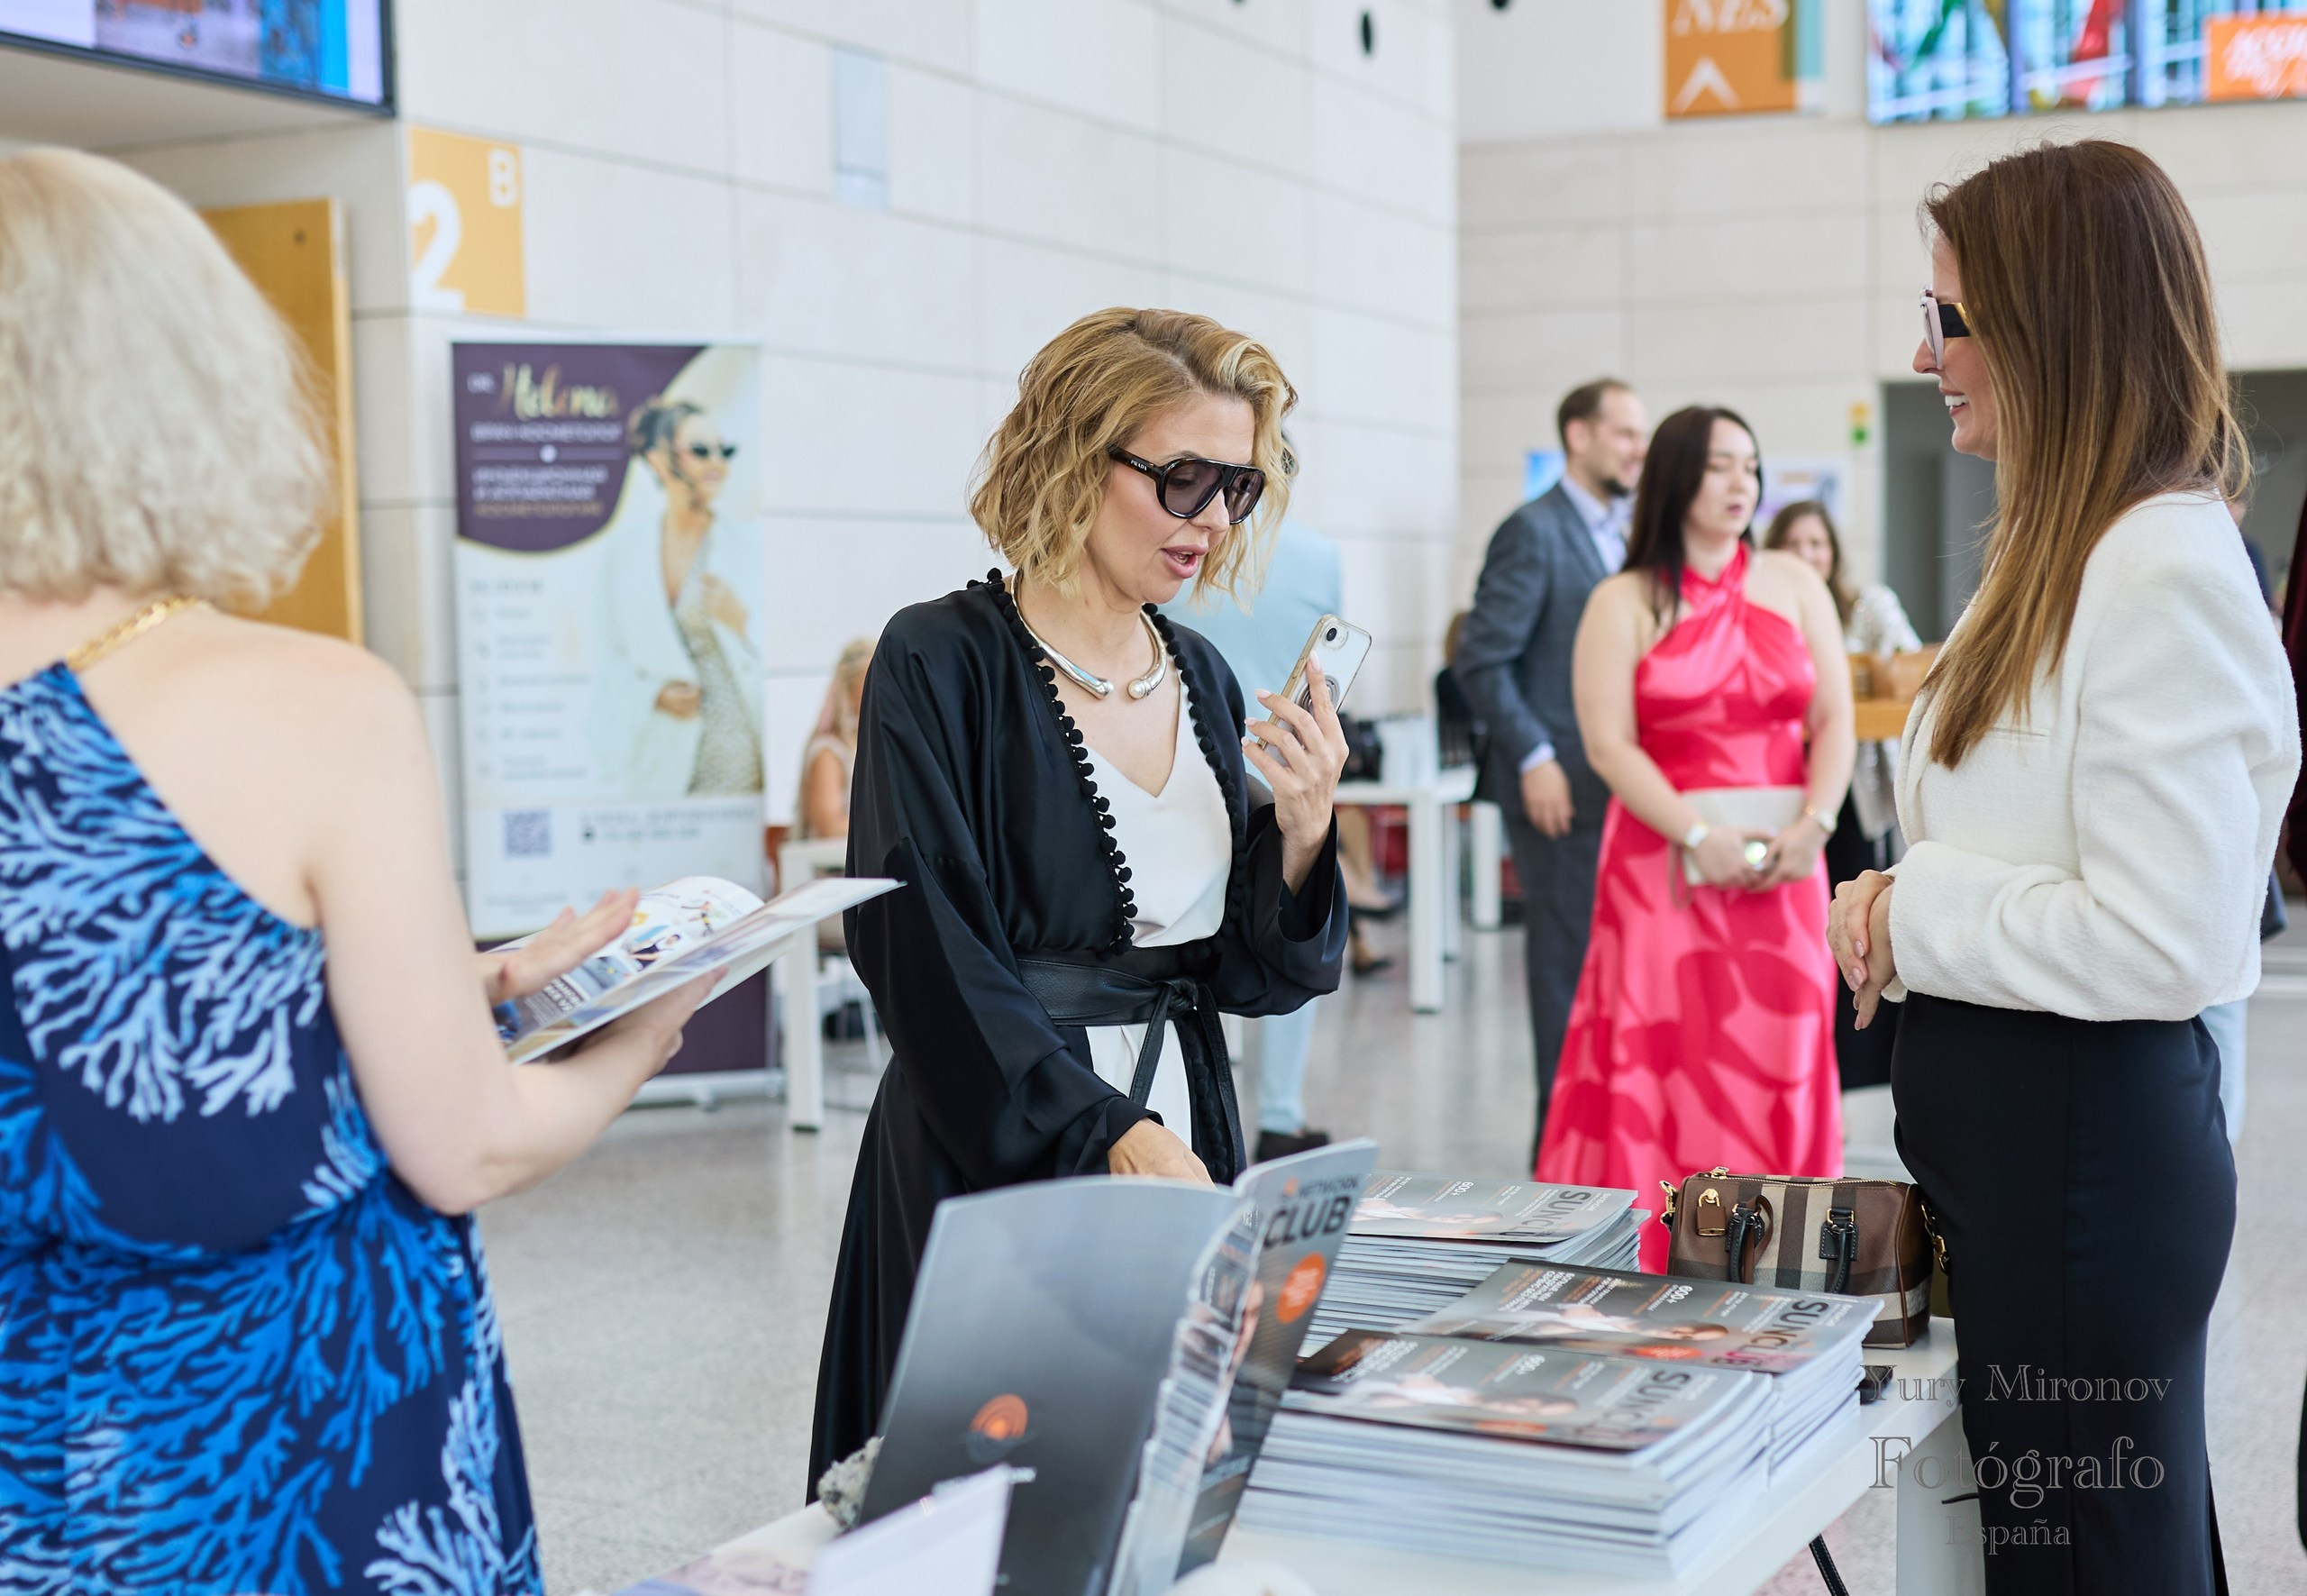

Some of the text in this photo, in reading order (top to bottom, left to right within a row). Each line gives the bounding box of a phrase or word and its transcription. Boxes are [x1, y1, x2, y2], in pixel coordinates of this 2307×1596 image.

[487, 148, 518, 207] B
[408, 178, 465, 313] 2
[1130, 459, 1147, 471] PRADA
[1451, 1181, 1474, 1196] 600+
[1500, 1190, 1592, 1237] SUNCLU
[1666, 1284, 1693, 1304] 600+
